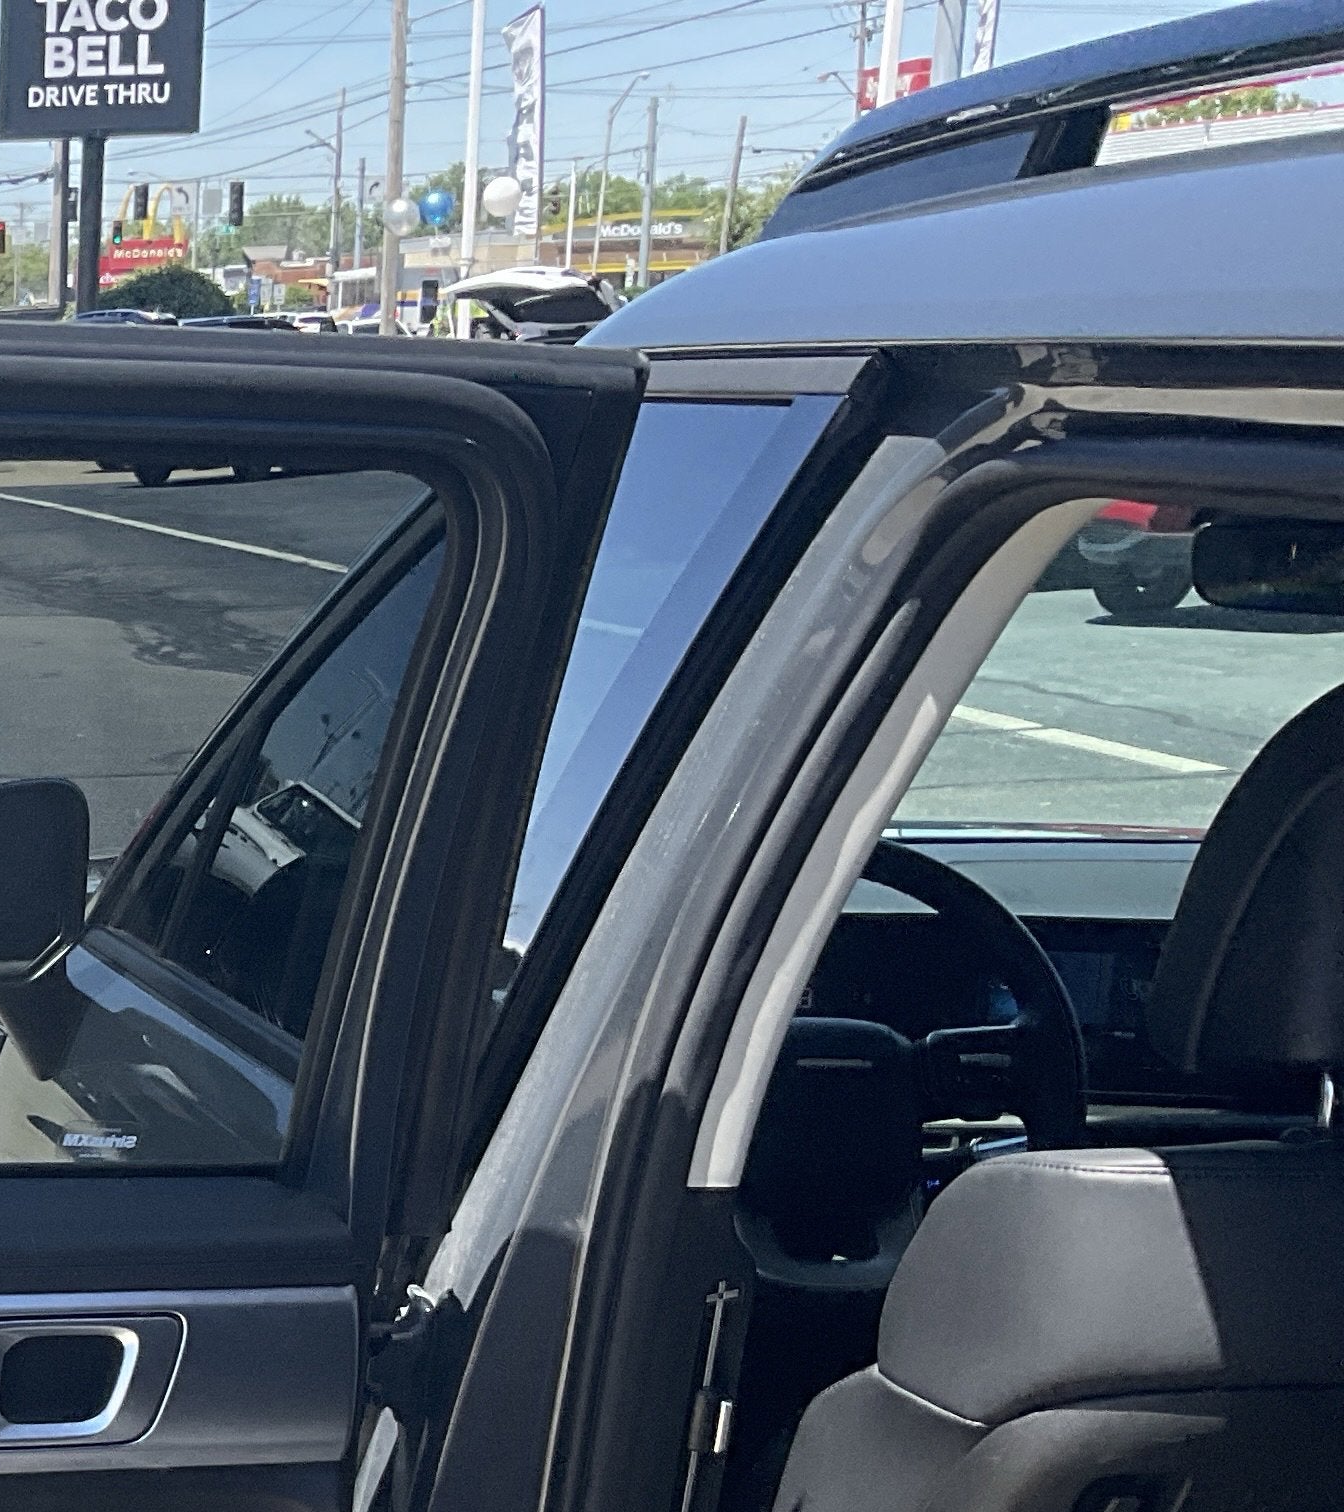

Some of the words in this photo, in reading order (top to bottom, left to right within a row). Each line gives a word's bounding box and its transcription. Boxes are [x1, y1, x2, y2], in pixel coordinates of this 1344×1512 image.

[36, 0, 168, 33] TACO
[44, 34, 164, 78] BELL
[28, 85, 98, 108] DRIVE
[104, 82, 170, 105] THRU
[600, 222, 683, 237] McDoald's
